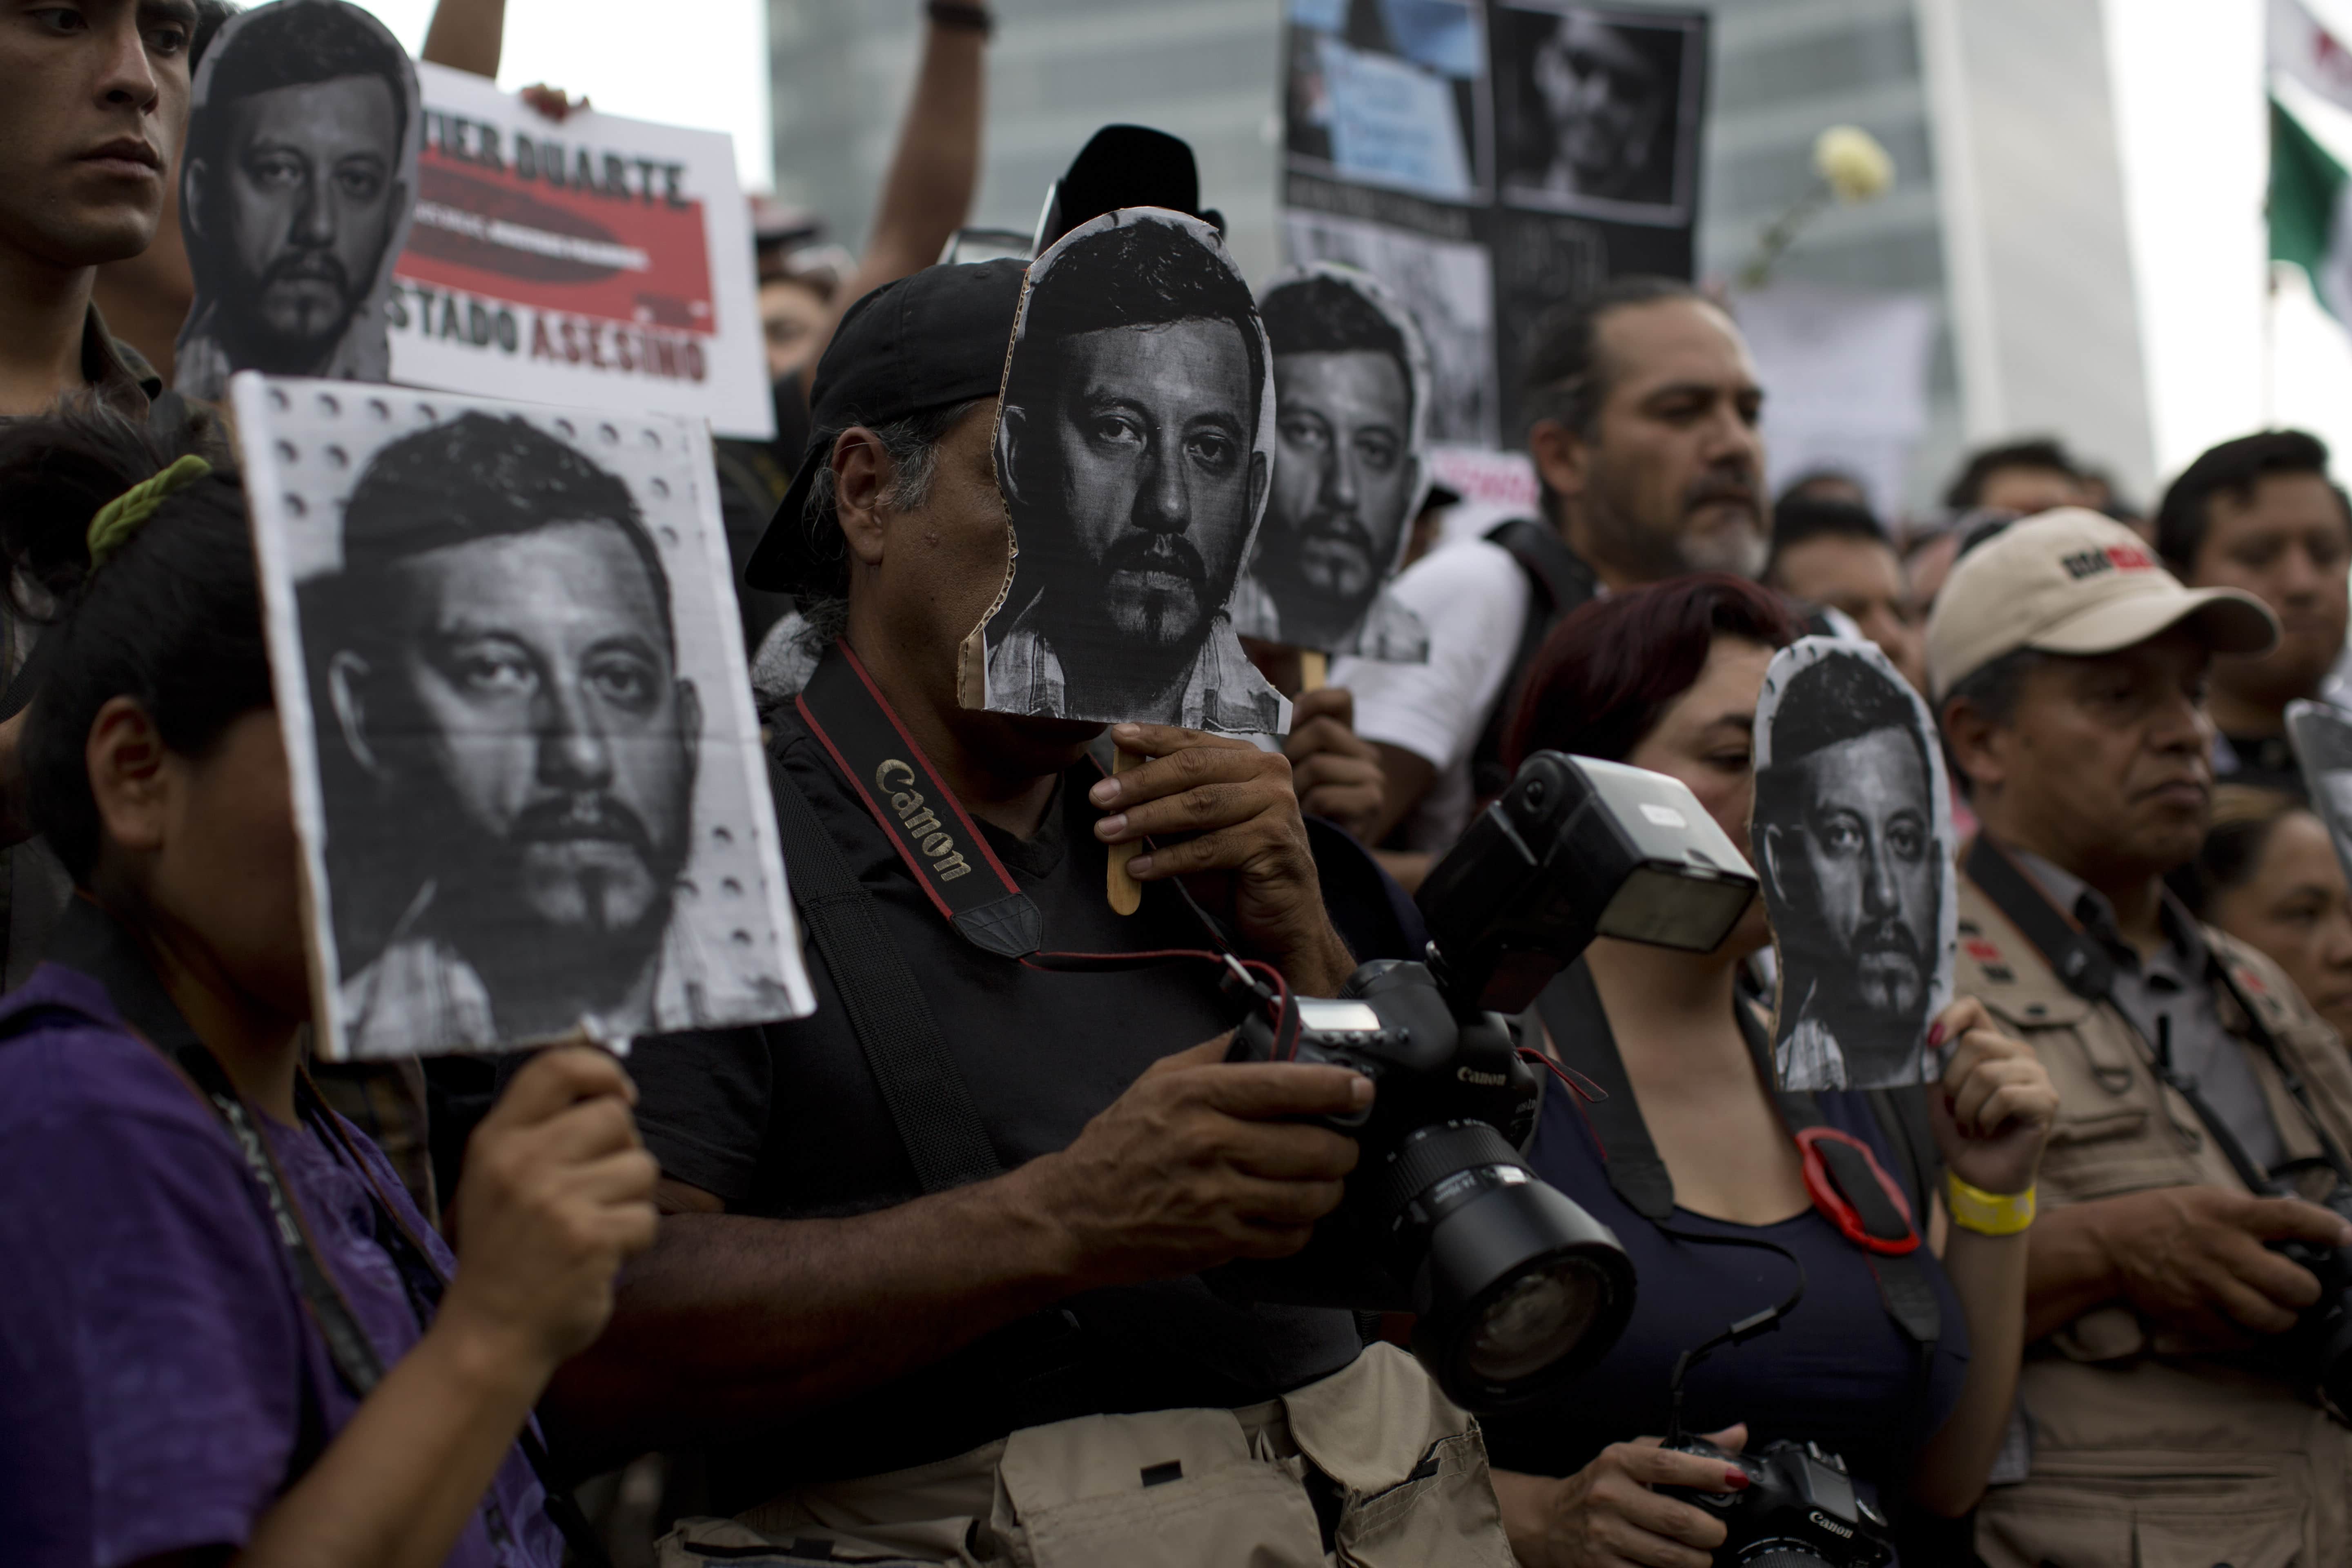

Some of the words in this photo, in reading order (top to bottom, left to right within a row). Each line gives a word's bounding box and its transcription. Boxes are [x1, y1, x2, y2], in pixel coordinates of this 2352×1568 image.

[514, 130, 690, 208] DUARTE
[531, 314, 707, 382] ASESINO
[875, 759, 971, 882] Canon
[1457, 1066, 1507, 1086] Canon
[1809, 1510, 1854, 1539] Canon
